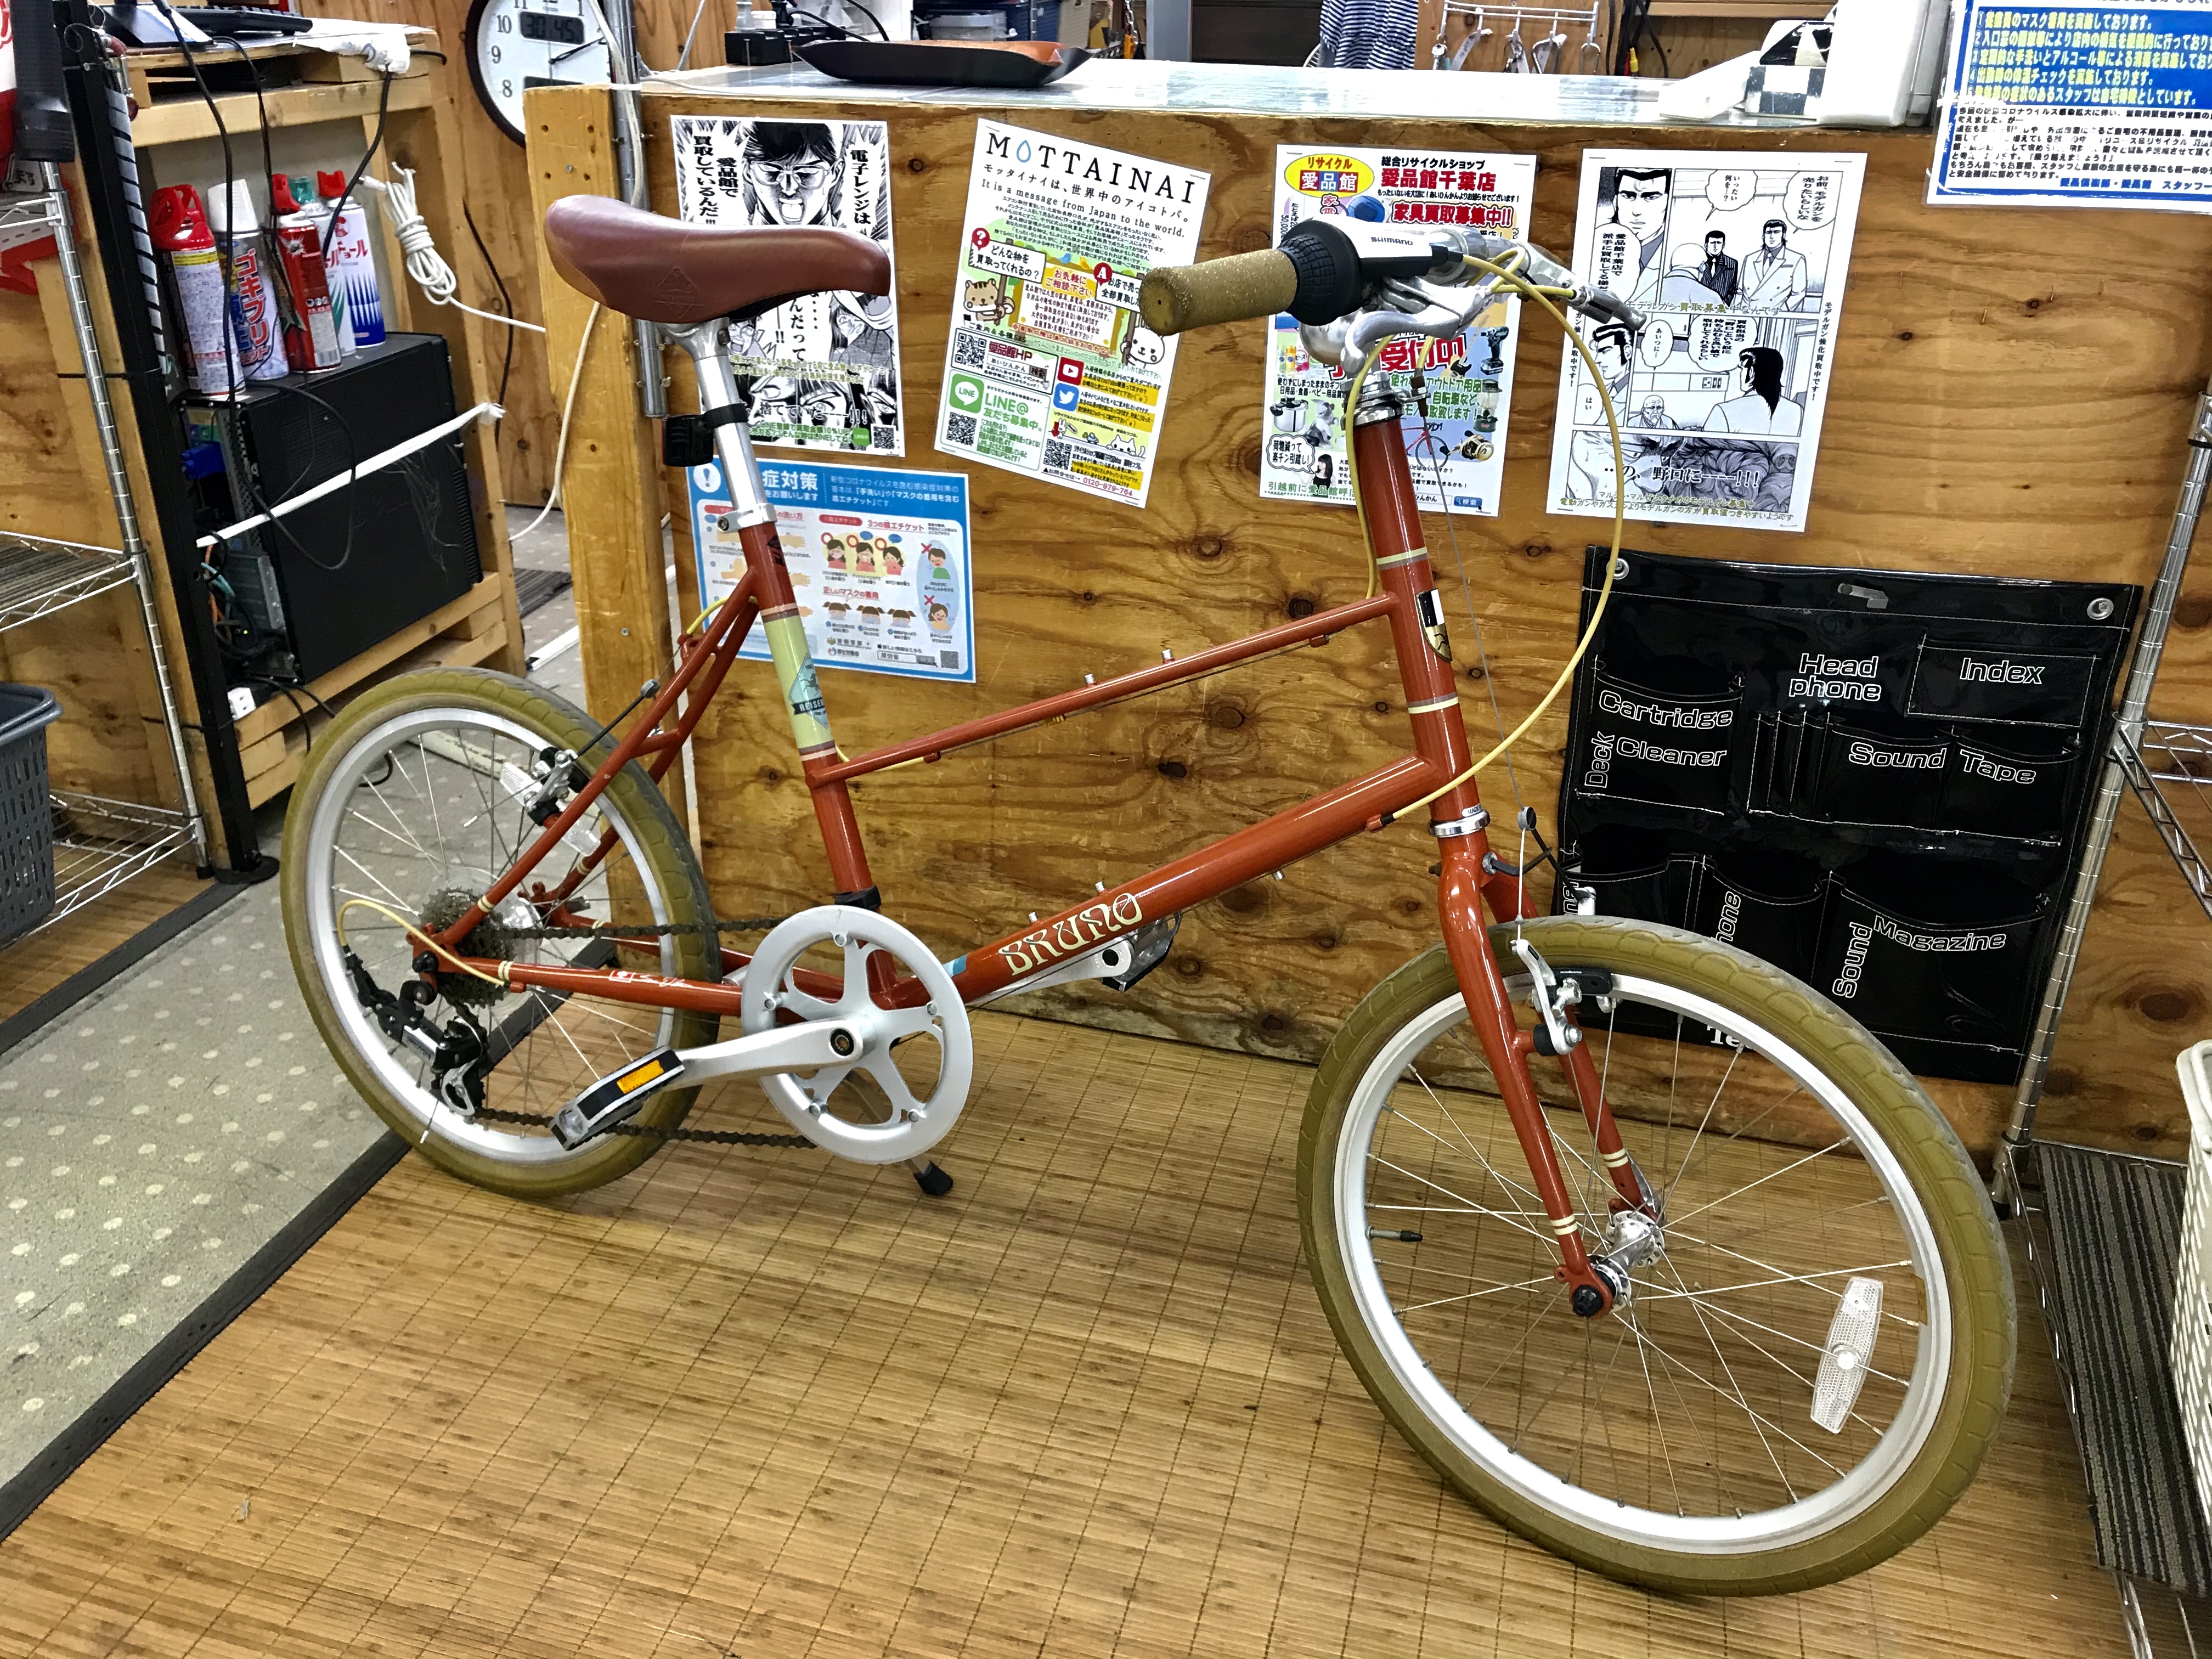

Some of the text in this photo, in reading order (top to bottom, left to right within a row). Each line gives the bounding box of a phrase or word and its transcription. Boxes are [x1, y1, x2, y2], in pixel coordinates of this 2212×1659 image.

[496, 15, 512, 33] 10
[492, 46, 501, 64] 9
[502, 80, 512, 97] 8
[1307, 156, 1353, 170] リサイクル
[1381, 156, 1485, 170] 総合リサイクルショップ
[715, 157, 739, 198] 愛品館で
[850, 150, 871, 224] 電子レンジは
[1301, 172, 1359, 191] 愛品館
[1381, 167, 1497, 193] 愛品館千葉店
[1730, 176, 1741, 201] いったい
[984, 164, 1188, 223] モッタイナイは、世界中のアイコトバ。
[1797, 177, 1815, 221] 売りたいらしいな
[1811, 176, 1829, 222] お前、モデルガンを
[981, 178, 990, 188] It
[994, 182, 1003, 192] is
[1016, 190, 1058, 206] message
[1062, 200, 1085, 213] from
[1088, 206, 1116, 223] Japan
[1121, 215, 1131, 224] to
[1134, 218, 1151, 230] the
[1154, 223, 1185, 238] world.
[1371, 236, 1414, 246] SHIMANO
[976, 253, 1039, 279] 買取ってくれるの？
[990, 246, 1029, 264] どんな物を
[1611, 233, 1627, 276] 愛品館千葉店で
[1044, 278, 1093, 297] ご相談下さい
[1054, 269, 1087, 285] お気軽に
[234, 247, 269, 346] ゴキブリ
[989, 341, 1032, 361] 愛品館HP
[991, 358, 1026, 373] あいひんかん
[958, 387, 975, 398] LINE
[985, 392, 1029, 415] LINE@
[1585, 397, 1593, 410] はい
[761, 470, 819, 491] 症対策
[1083, 477, 1133, 496] 0120-979-764
[1462, 496, 1478, 506] 検索
[1799, 653, 1879, 679] Head
[1959, 657, 2045, 685] Index
[1789, 675, 1881, 702] phone
[1598, 689, 1734, 730] Cartridge
[1584, 731, 1615, 788] Deck
[1615, 738, 1727, 768] Cleaner
[1848, 743, 1946, 770] Sound
[1958, 748, 2037, 786] Tape
[998, 892, 1143, 976] BRUNO
[1874, 915, 2006, 951] Magazine
[1832, 922, 1872, 998] Sound
